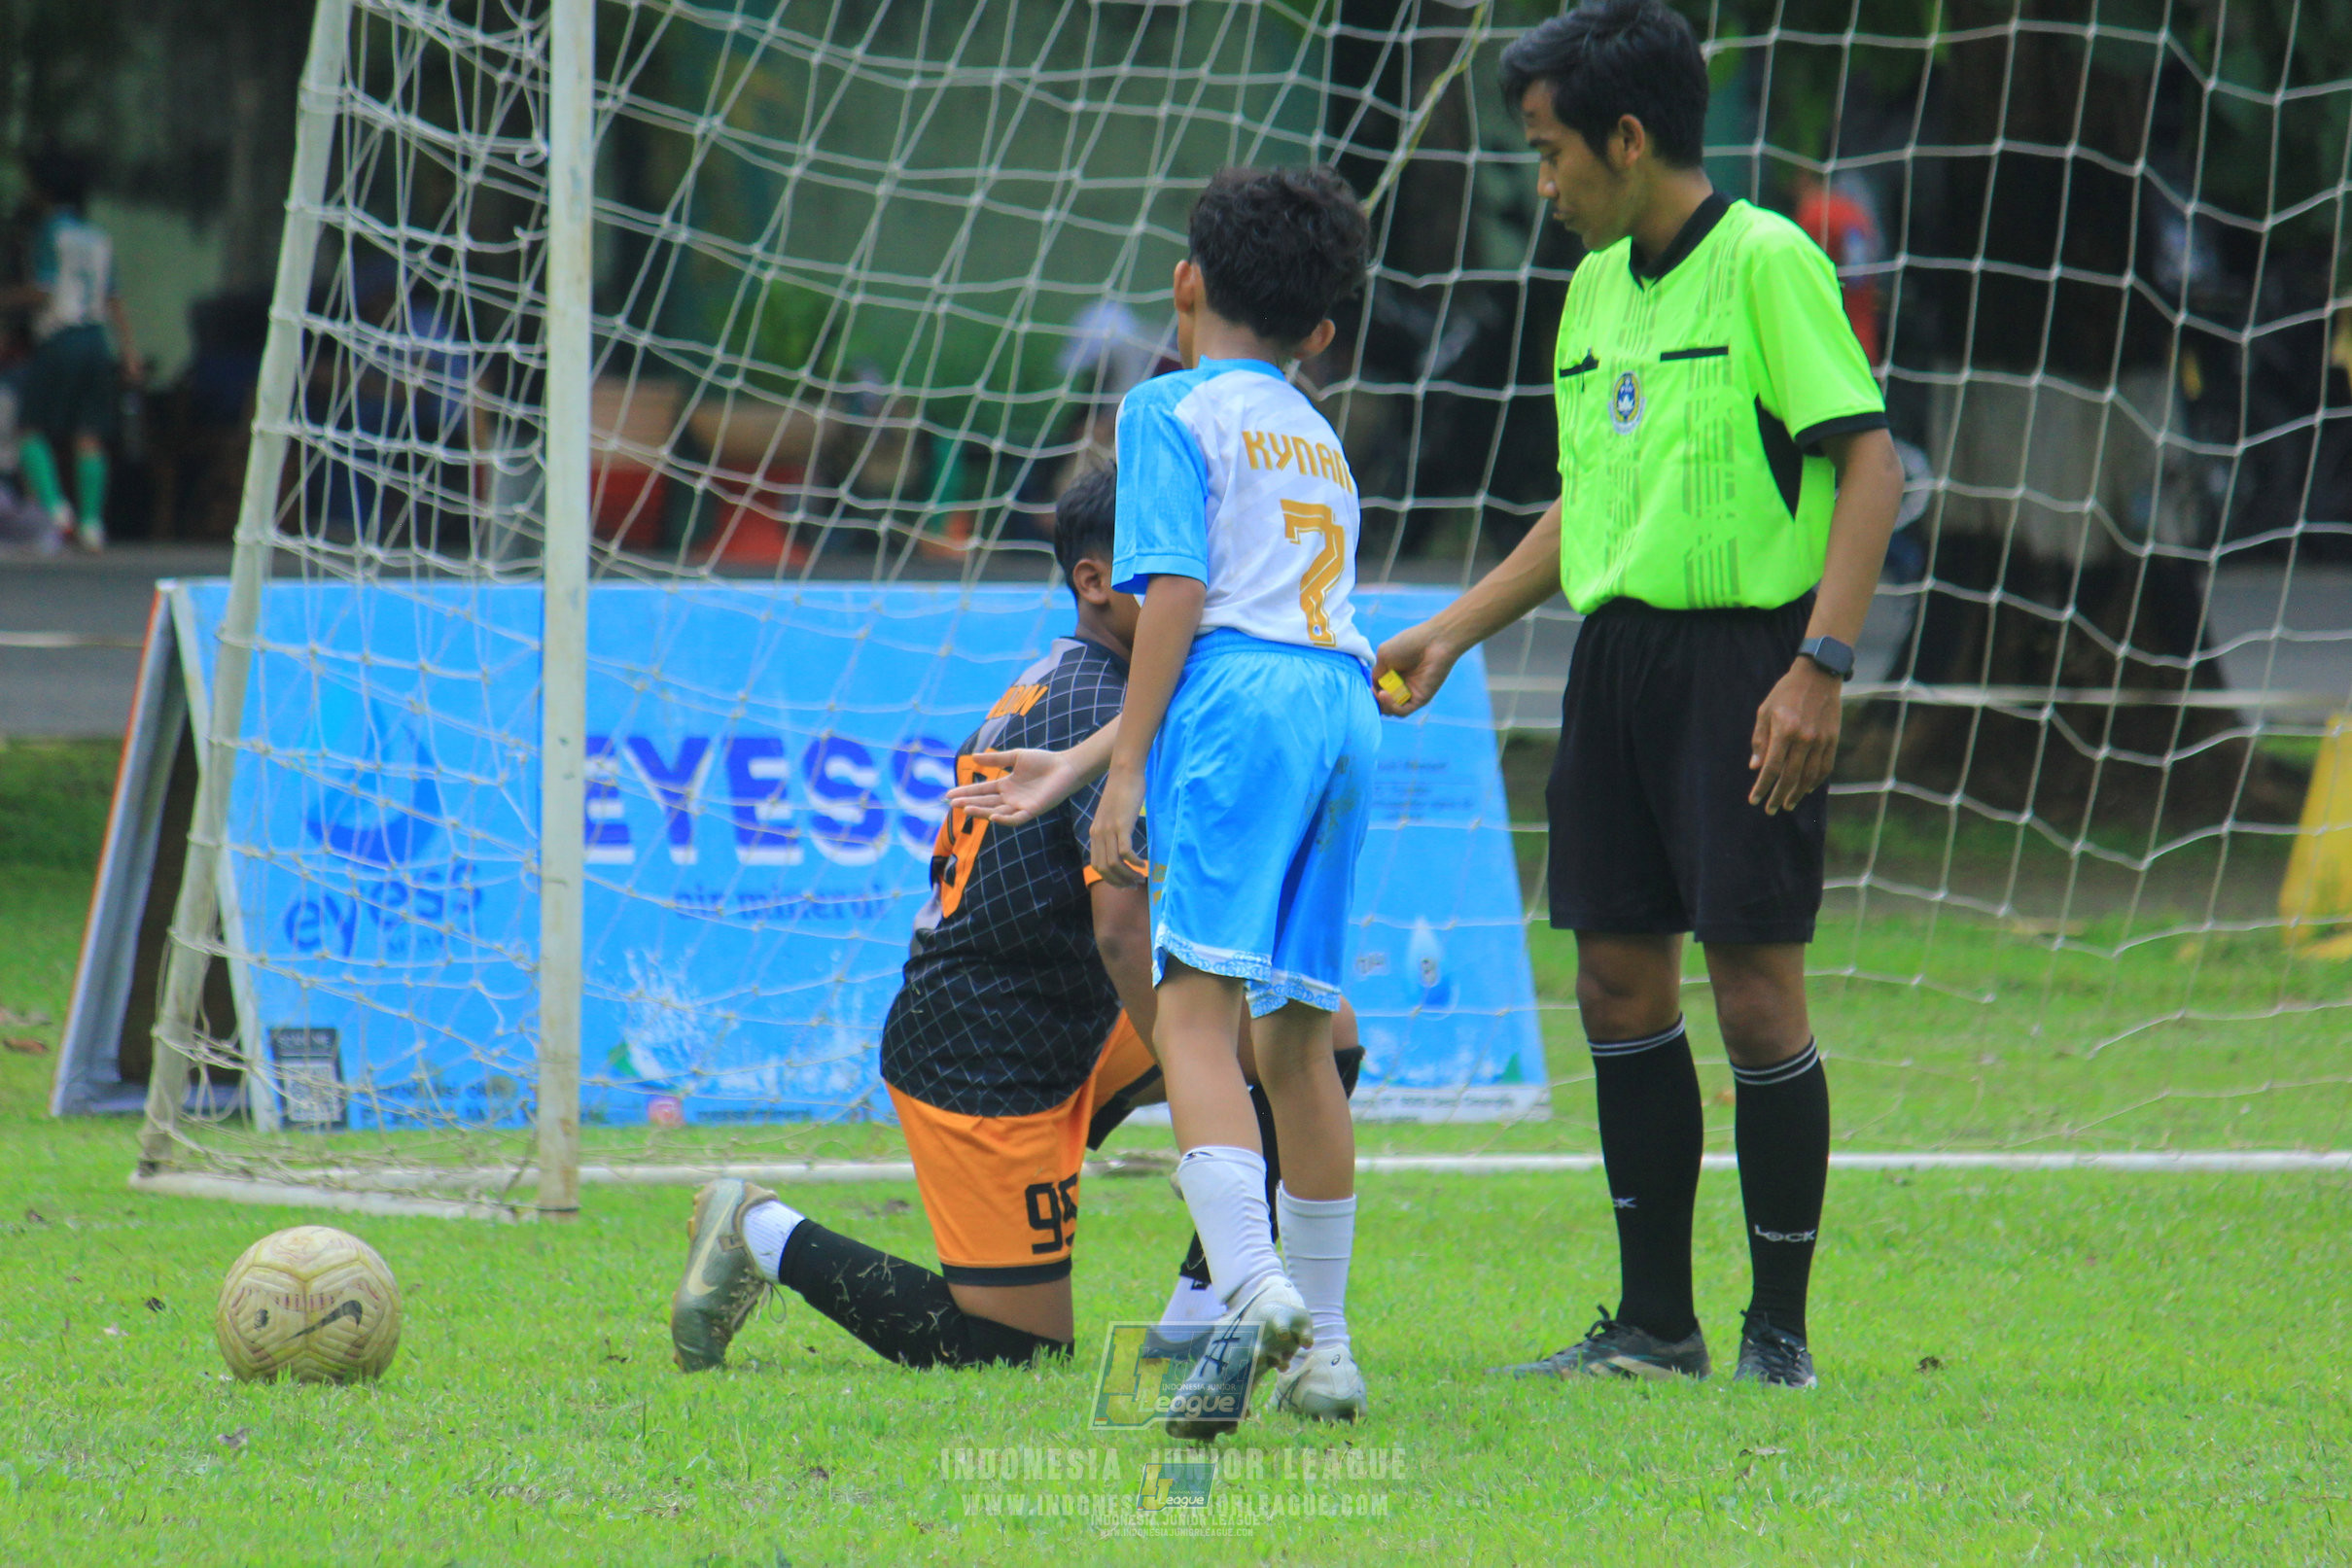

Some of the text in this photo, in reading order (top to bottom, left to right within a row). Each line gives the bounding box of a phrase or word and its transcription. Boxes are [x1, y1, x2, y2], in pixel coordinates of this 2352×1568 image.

[1242, 431, 1353, 495] KYNAN
[1280, 498, 1346, 647] 7
[584, 735, 957, 866] EYESS
[284, 863, 483, 957] eyess
[1754, 1223, 1817, 1242] LOCK
